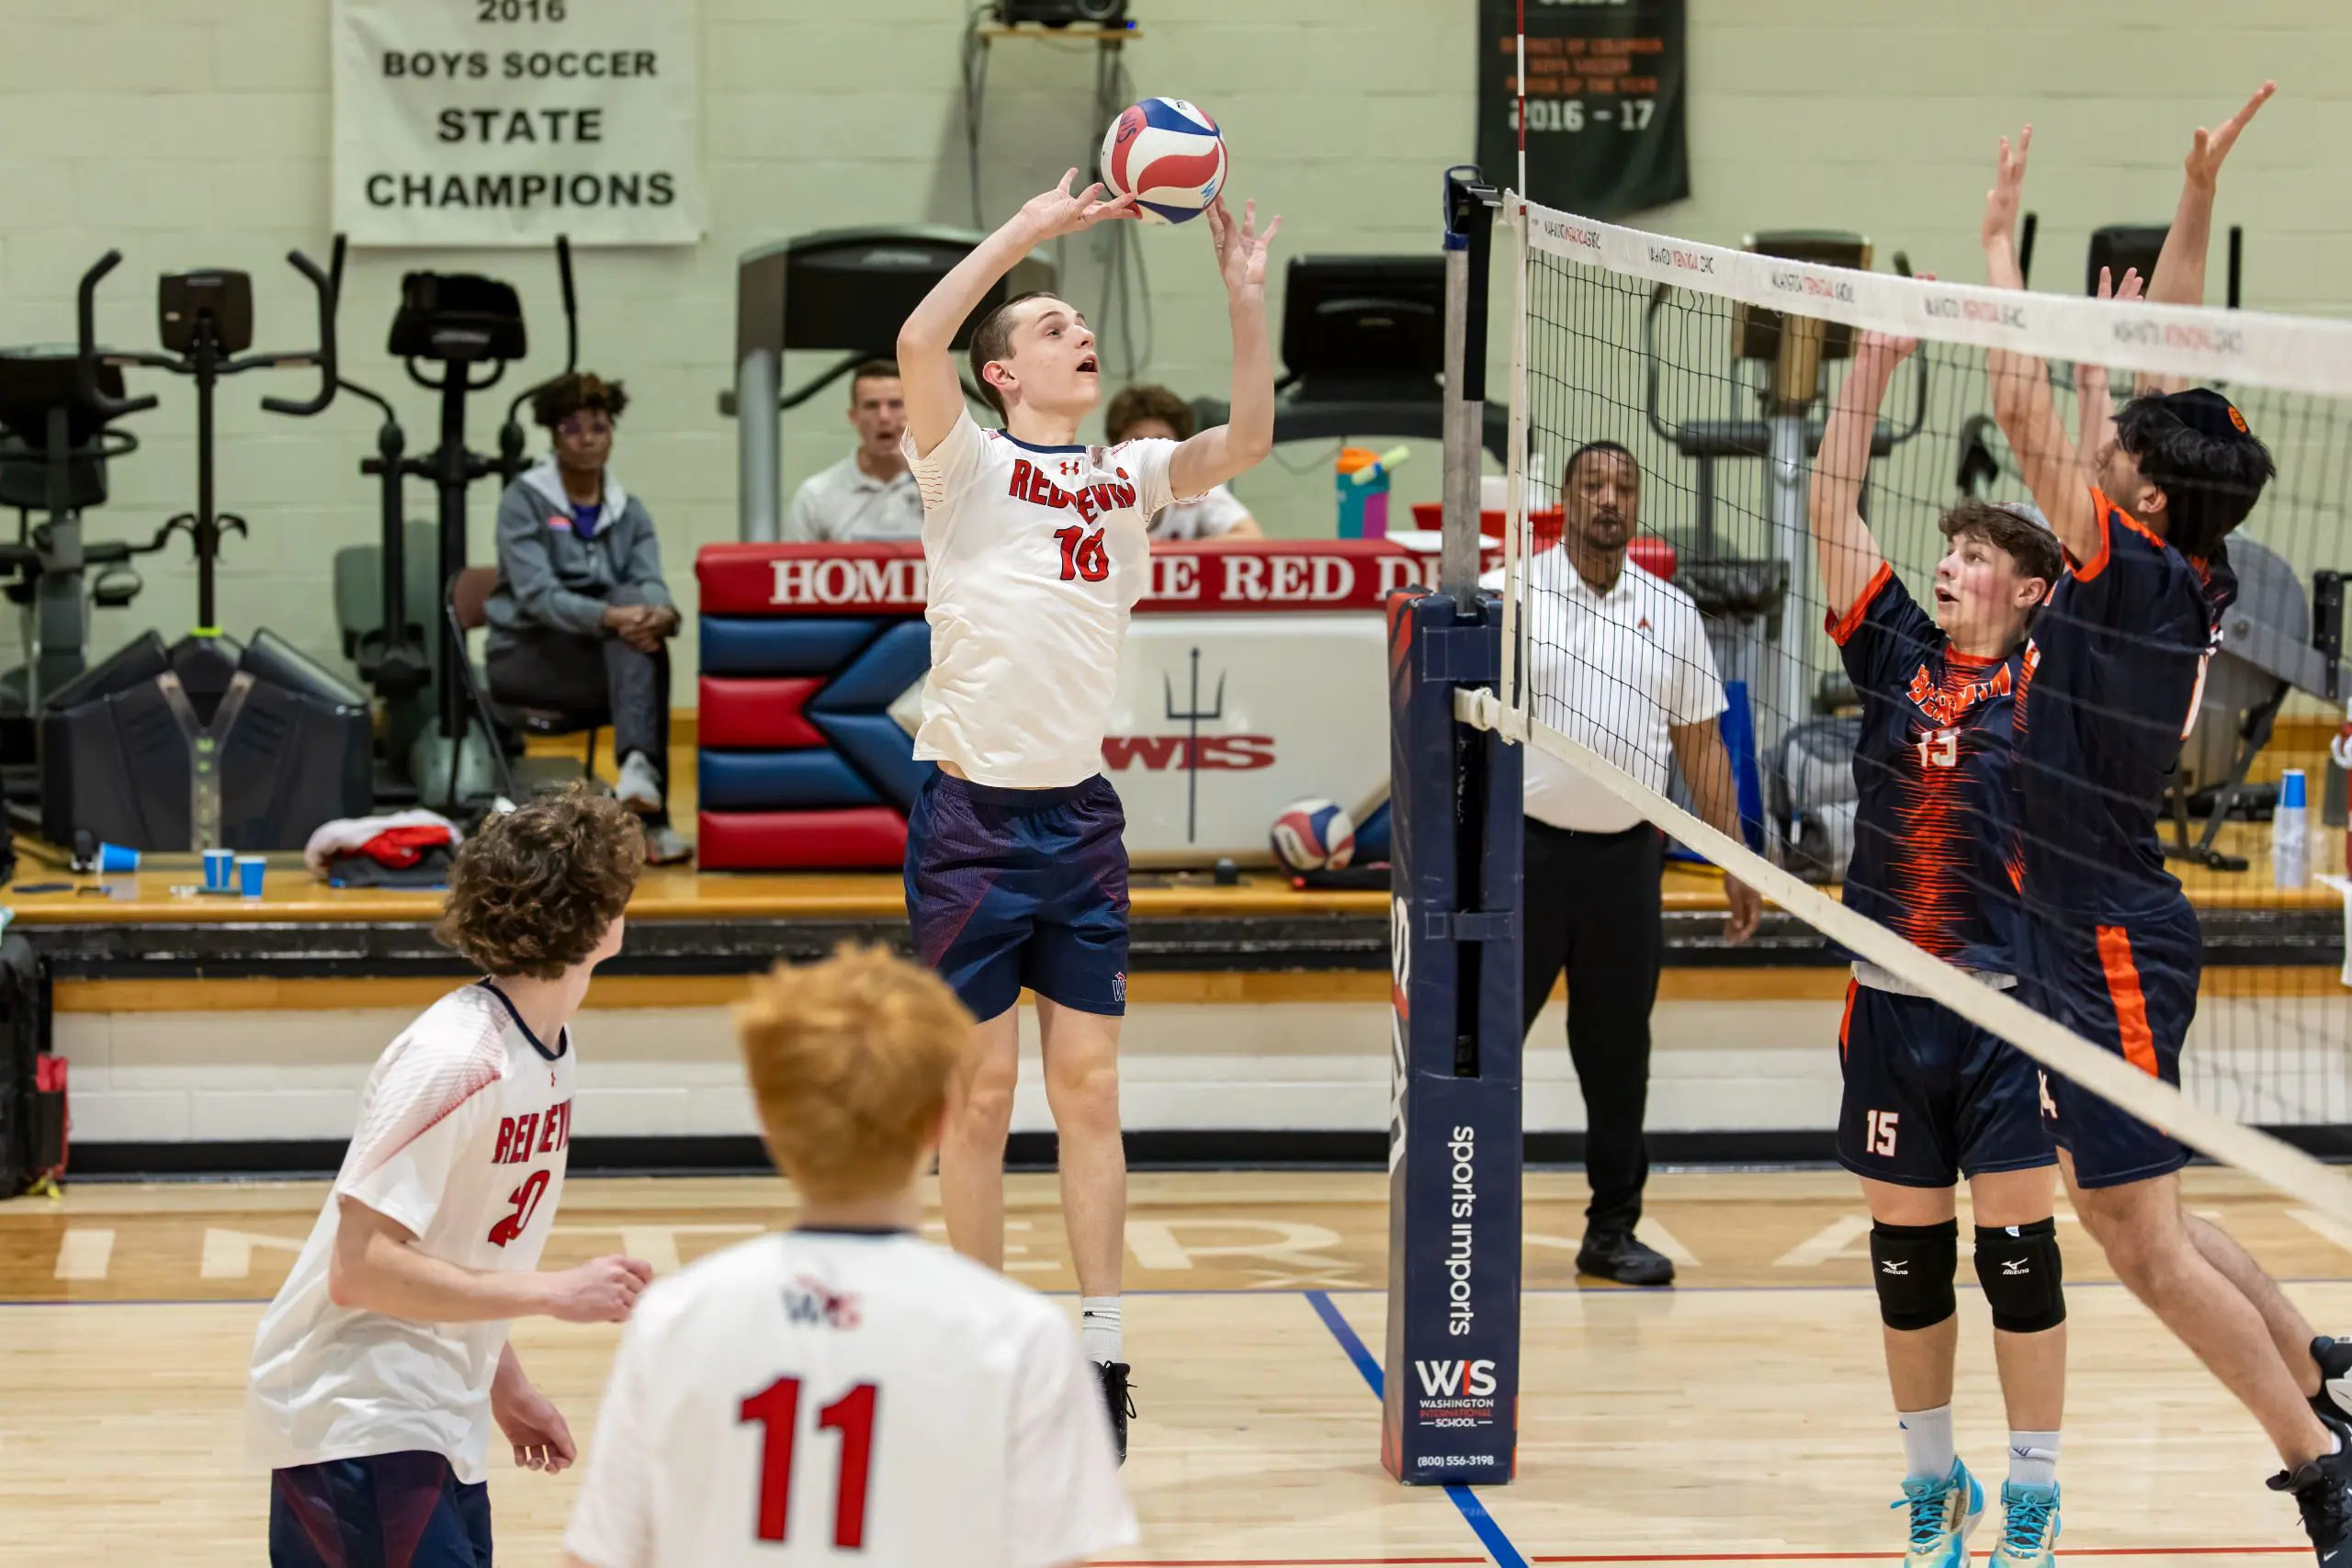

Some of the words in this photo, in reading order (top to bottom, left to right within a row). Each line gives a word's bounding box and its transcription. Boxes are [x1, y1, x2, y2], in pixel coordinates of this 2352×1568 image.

[477, 0, 568, 23] 2016
[382, 51, 490, 79] BOYS
[503, 51, 659, 79] SOCCER
[436, 107, 604, 144] STATE
[1508, 97, 1586, 132] 2016
[1619, 98, 1656, 132] 17
[366, 172, 676, 209] CHAMPIONS
[1220, 555, 1355, 600] RED
[1100, 735, 1277, 773] WIS
[1866, 1109, 1900, 1157] 15
[1447, 1124, 1477, 1219] sports
[1444, 1223, 1476, 1337] imports
[1415, 1359, 1498, 1397] WIS
[1419, 1398, 1495, 1409] WASHINGTON
[1435, 1417, 1478, 1428] SCHOOL
[738, 1374, 878, 1551] 11
[1418, 1456, 1445, 1468] (800)
[1446, 1455, 1495, 1467] 556-3198
